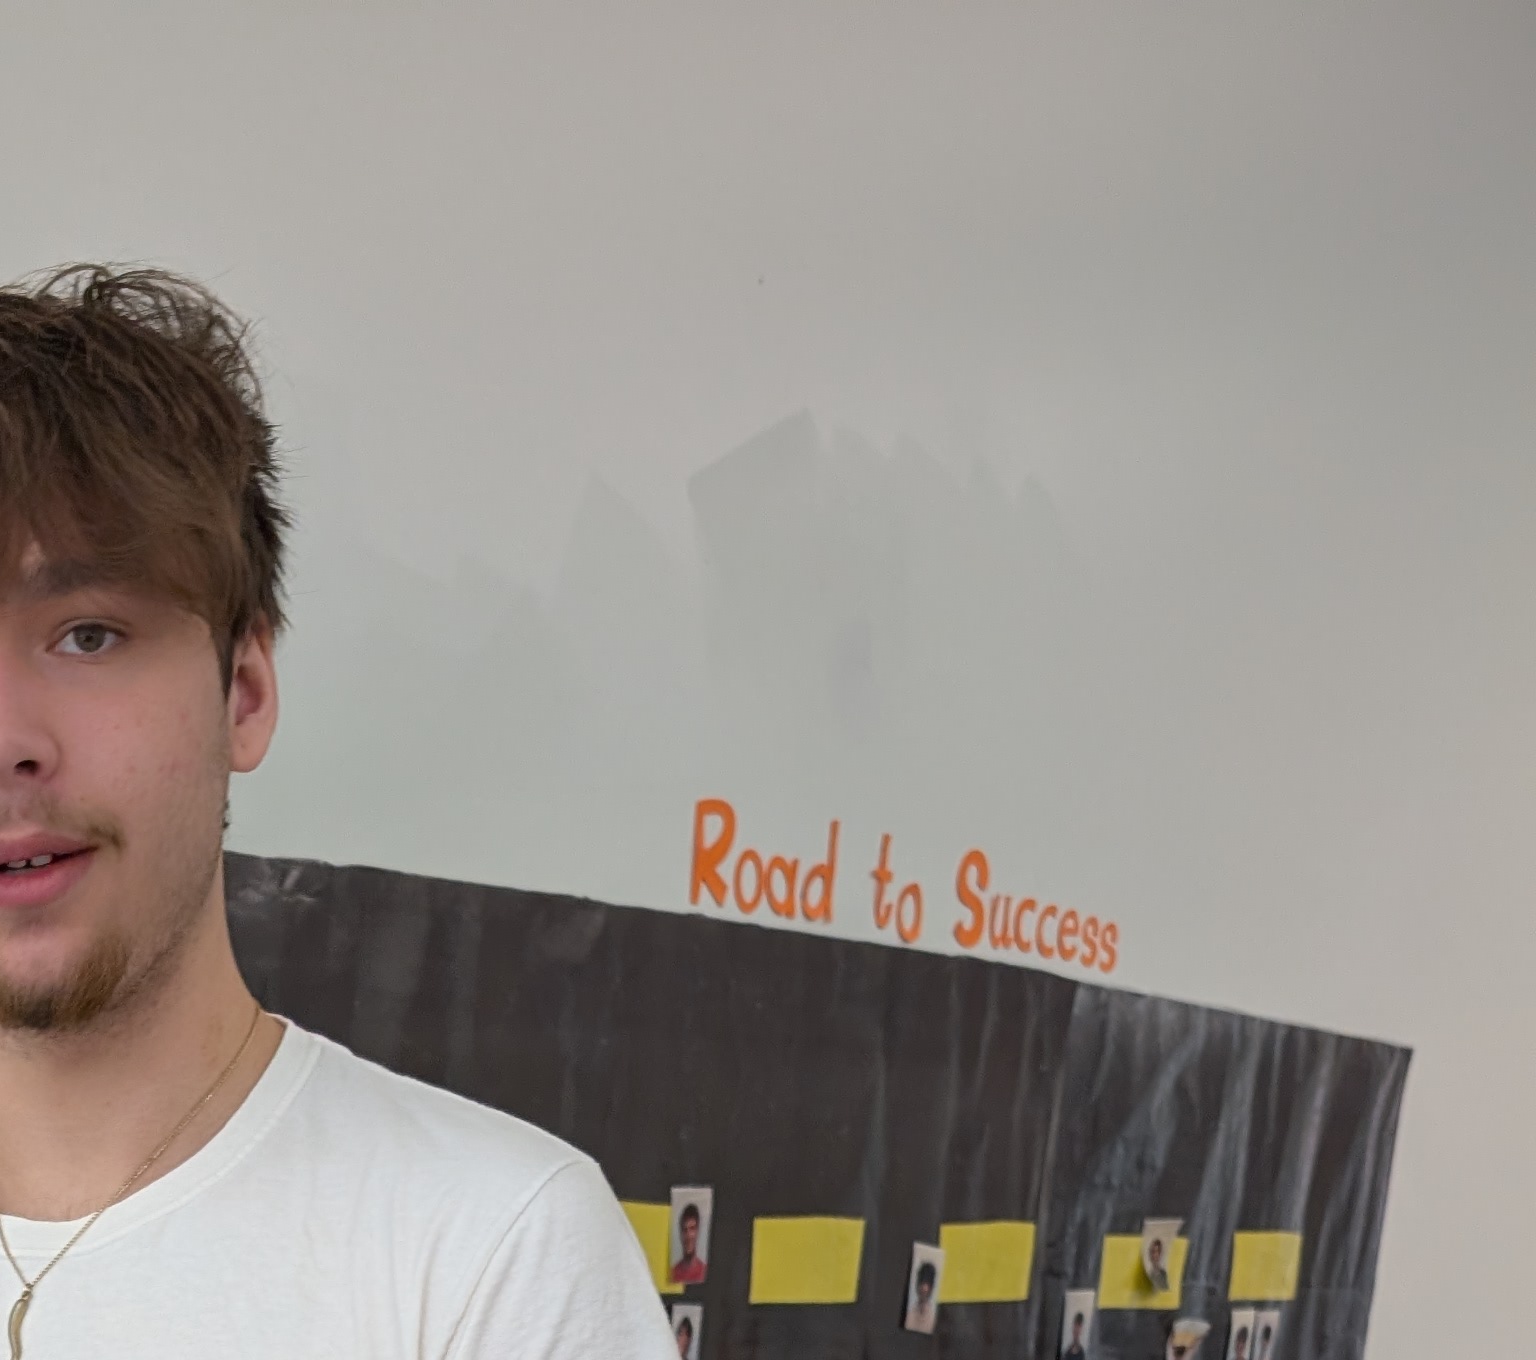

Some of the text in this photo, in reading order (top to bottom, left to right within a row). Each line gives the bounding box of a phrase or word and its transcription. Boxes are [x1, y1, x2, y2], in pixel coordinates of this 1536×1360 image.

[689, 797, 1119, 973] Road to Success
